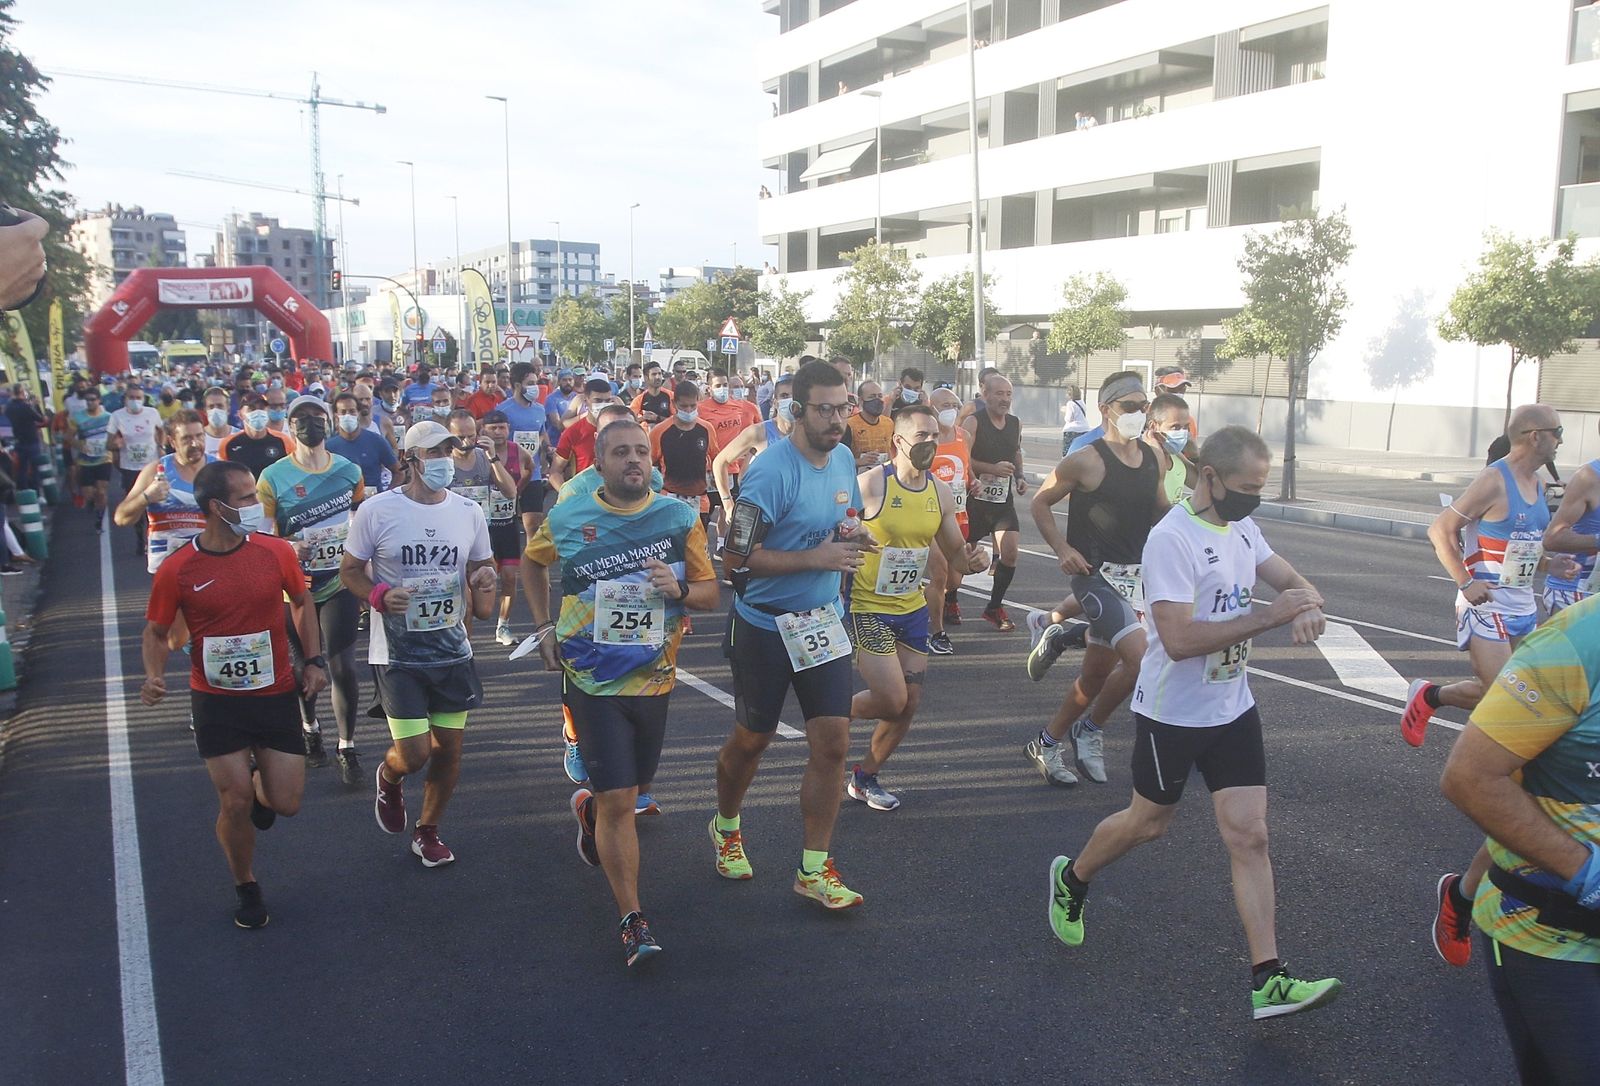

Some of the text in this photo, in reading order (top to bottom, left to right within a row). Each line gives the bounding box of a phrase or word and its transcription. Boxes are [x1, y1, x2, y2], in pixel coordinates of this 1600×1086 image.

[984, 487, 1003, 496] 403
[494, 502, 513, 512] 148
[317, 543, 346, 560] 194
[595, 552, 629, 570] MEDIA
[889, 569, 918, 584] 179
[418, 598, 454, 618] 178
[610, 610, 653, 630] 254
[804, 630, 830, 652] 35
[1221, 640, 1248, 667] 136
[219, 659, 262, 678] 481
